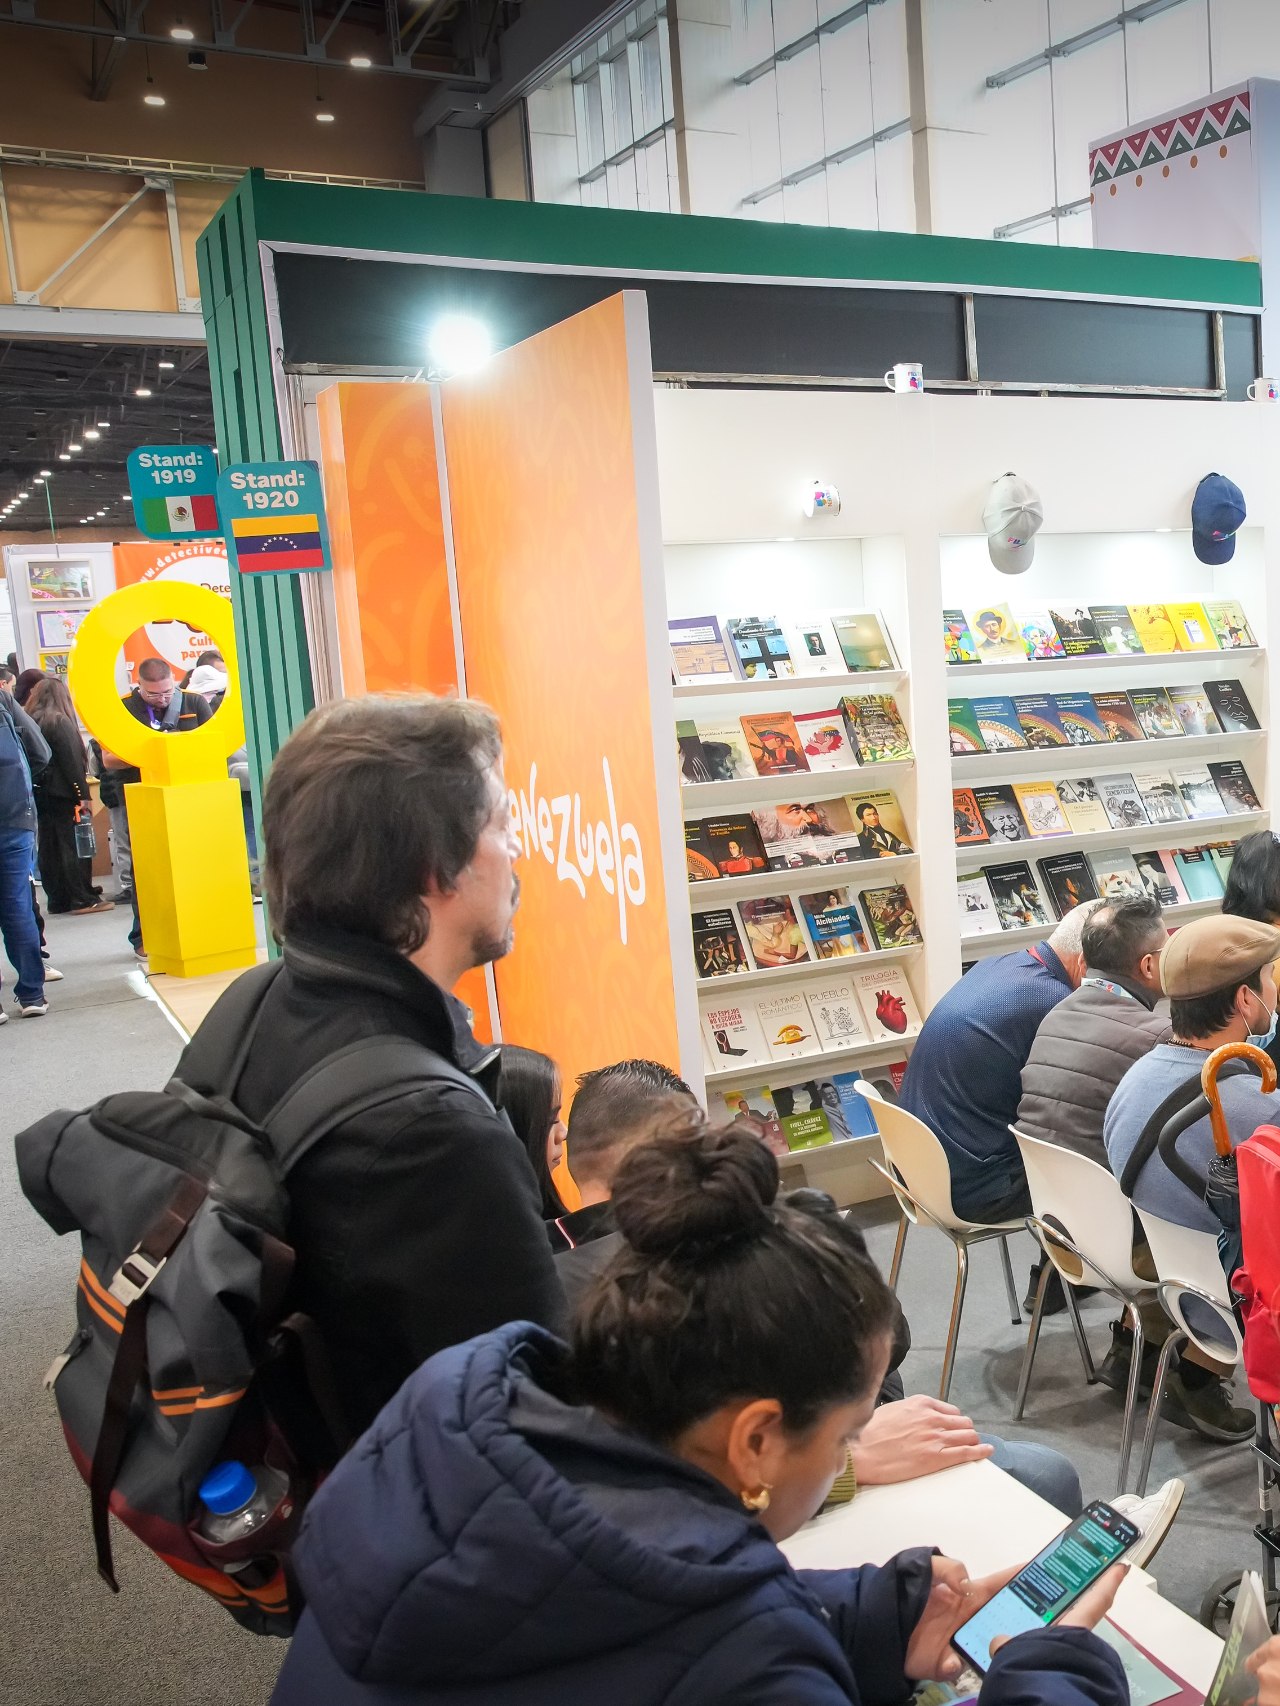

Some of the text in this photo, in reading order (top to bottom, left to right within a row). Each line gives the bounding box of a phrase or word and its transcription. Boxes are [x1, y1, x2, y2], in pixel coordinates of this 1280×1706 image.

[138, 452, 203, 468] Stand:
[151, 469, 197, 485] 1919
[230, 470, 306, 489] Stand:
[242, 490, 299, 510] 1920
[507, 756, 646, 946] enezuela
[860, 970, 898, 983] TRILOGÍA
[809, 988, 849, 1002] PUEBLO
